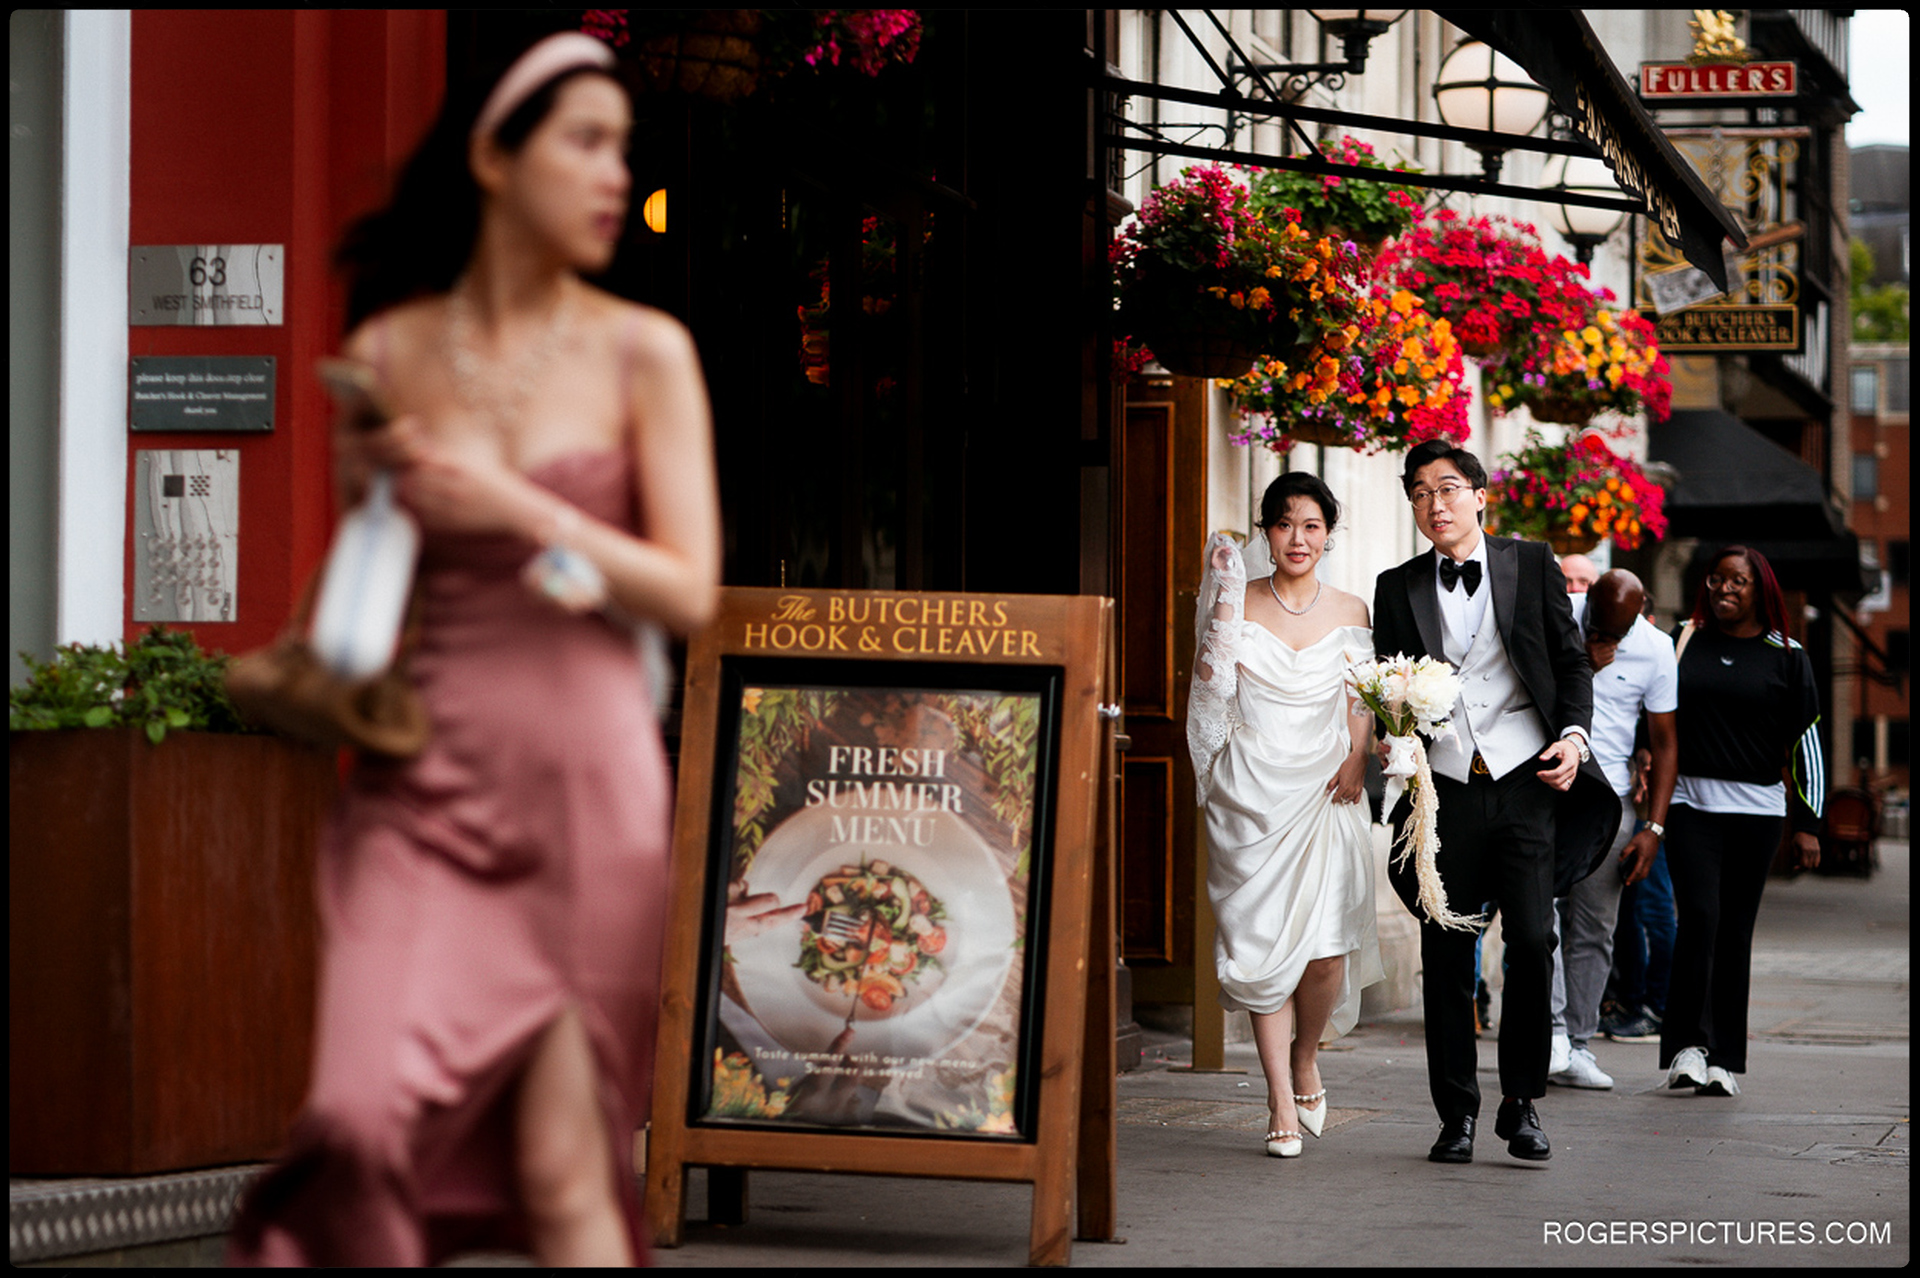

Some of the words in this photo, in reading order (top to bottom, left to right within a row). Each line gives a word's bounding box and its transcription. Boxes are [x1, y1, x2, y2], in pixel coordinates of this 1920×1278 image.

[189, 256, 227, 287] 63
[152, 294, 188, 311] WEST
[192, 294, 263, 311] SMITHFIELD
[1684, 312, 1777, 326] BUTCHERS
[1654, 326, 1695, 343] OOK
[1698, 328, 1713, 343] &
[1715, 326, 1792, 342] CLEAVER
[136, 373, 163, 385] please
[165, 373, 186, 385] keep
[188, 373, 204, 383] this
[770, 594, 816, 622] The
[828, 597, 1008, 626] BUTCHERS
[744, 623, 849, 651] HOOK
[857, 627, 882, 652] &
[892, 626, 1043, 657] CLEAVER
[827, 745, 947, 778] FRESH
[804, 779, 964, 813] SUMMER
[829, 815, 937, 847] MENU
[754, 1046, 789, 1060] Taste
[793, 1051, 844, 1062] summer
[851, 1052, 878, 1063] with
[883, 1056, 905, 1065] our
[910, 1058, 935, 1067] new
[805, 1062, 858, 1076] Summer
[863, 1066, 875, 1076] is
